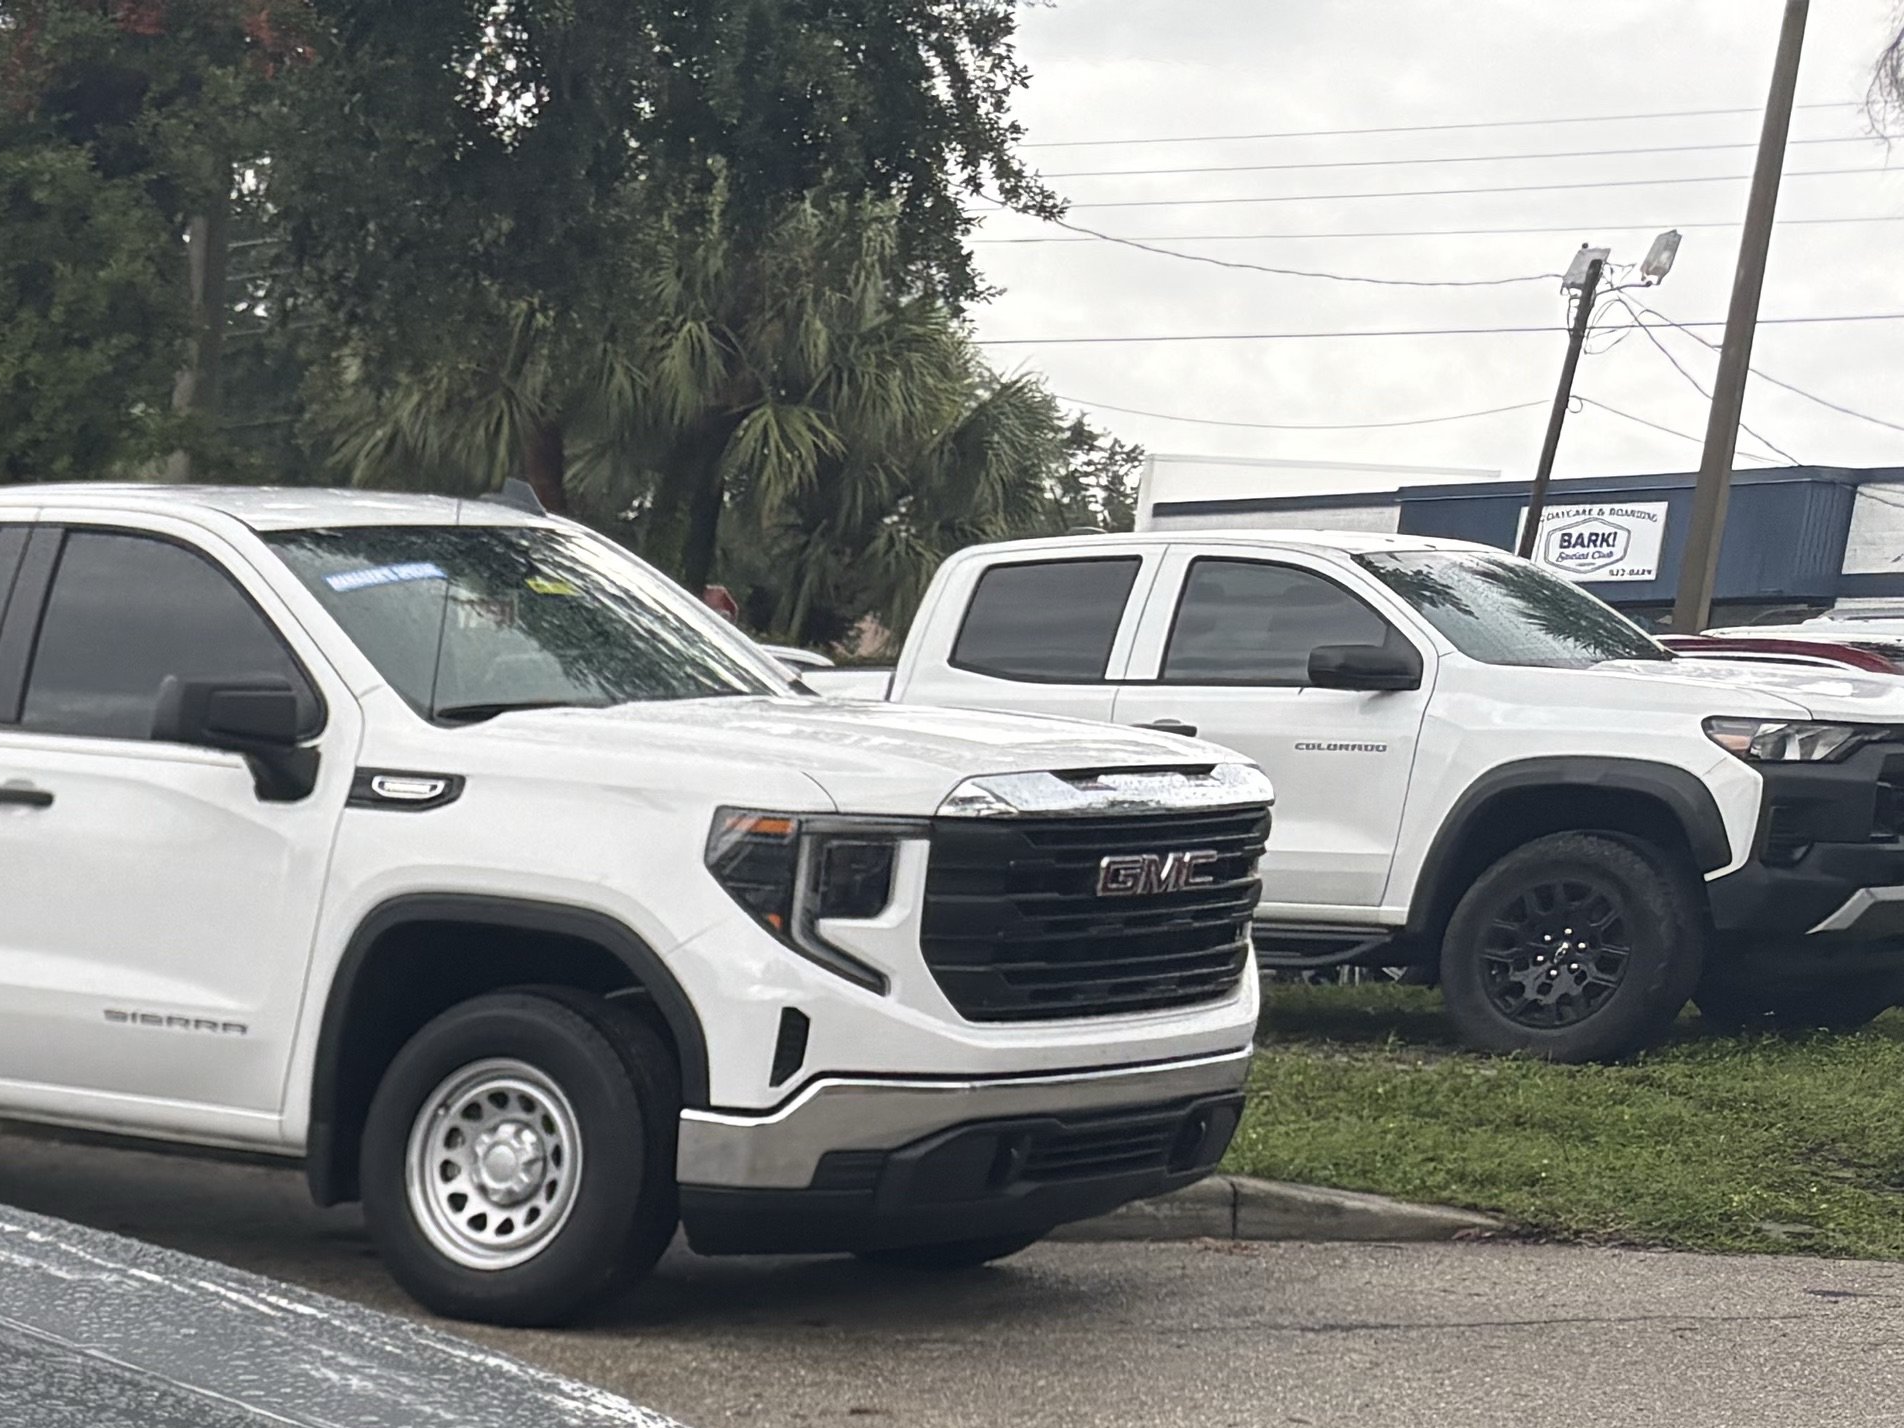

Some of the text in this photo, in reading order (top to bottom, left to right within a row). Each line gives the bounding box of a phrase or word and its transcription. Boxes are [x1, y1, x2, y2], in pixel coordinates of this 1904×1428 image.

[1559, 531, 1618, 549] BARK!
[1294, 742, 1388, 753] COLORADO
[1096, 850, 1217, 896] GMC
[103, 1009, 249, 1035] SIERRA
